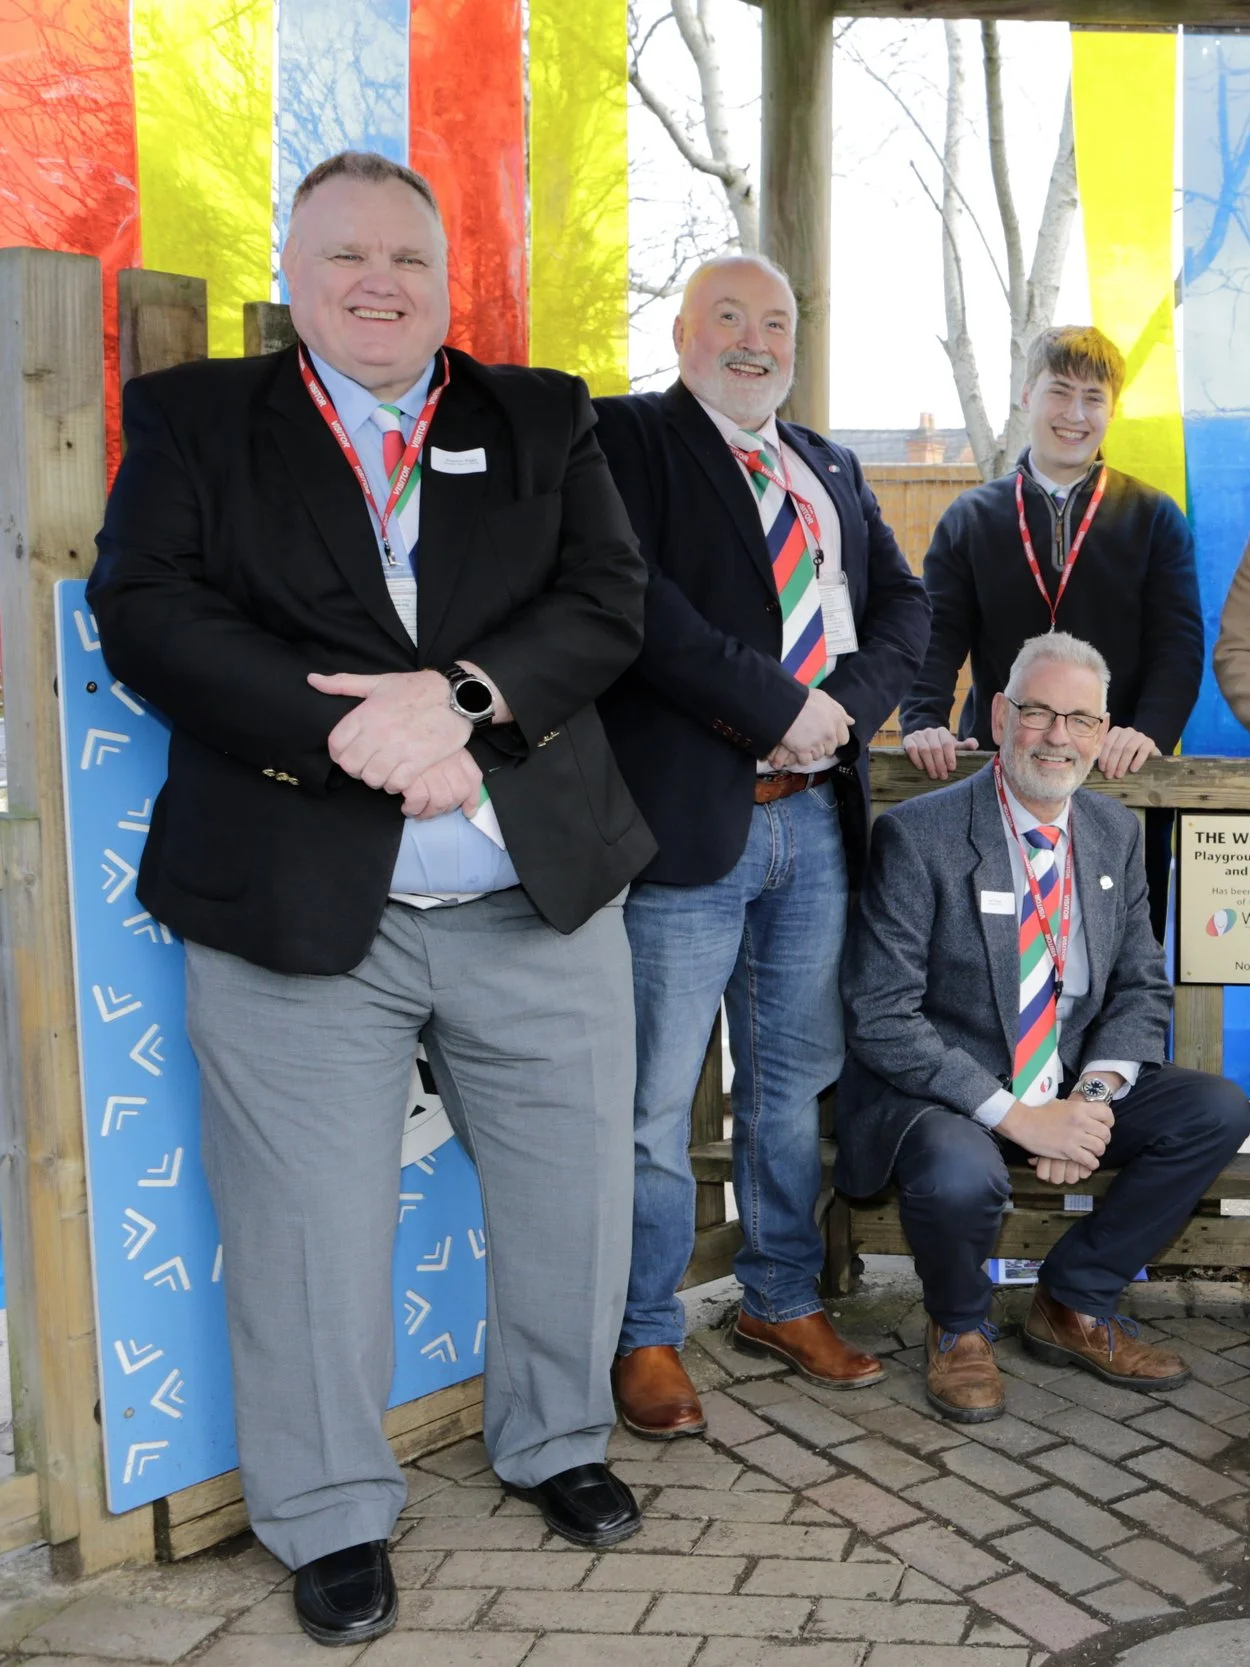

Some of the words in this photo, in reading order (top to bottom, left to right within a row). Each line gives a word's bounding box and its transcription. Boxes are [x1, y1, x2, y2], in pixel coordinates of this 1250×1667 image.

[309, 380, 327, 407] VISITOR
[331, 420, 350, 448] VISITOR
[411, 420, 428, 448] VISITOR
[393, 465, 411, 496] VISITOR
[1195, 832, 1226, 844] THE
[1225, 867, 1248, 876] and
[1212, 887, 1228, 895] Has
[1236, 898, 1247, 906] of
[1034, 894, 1046, 920] VISITOR
